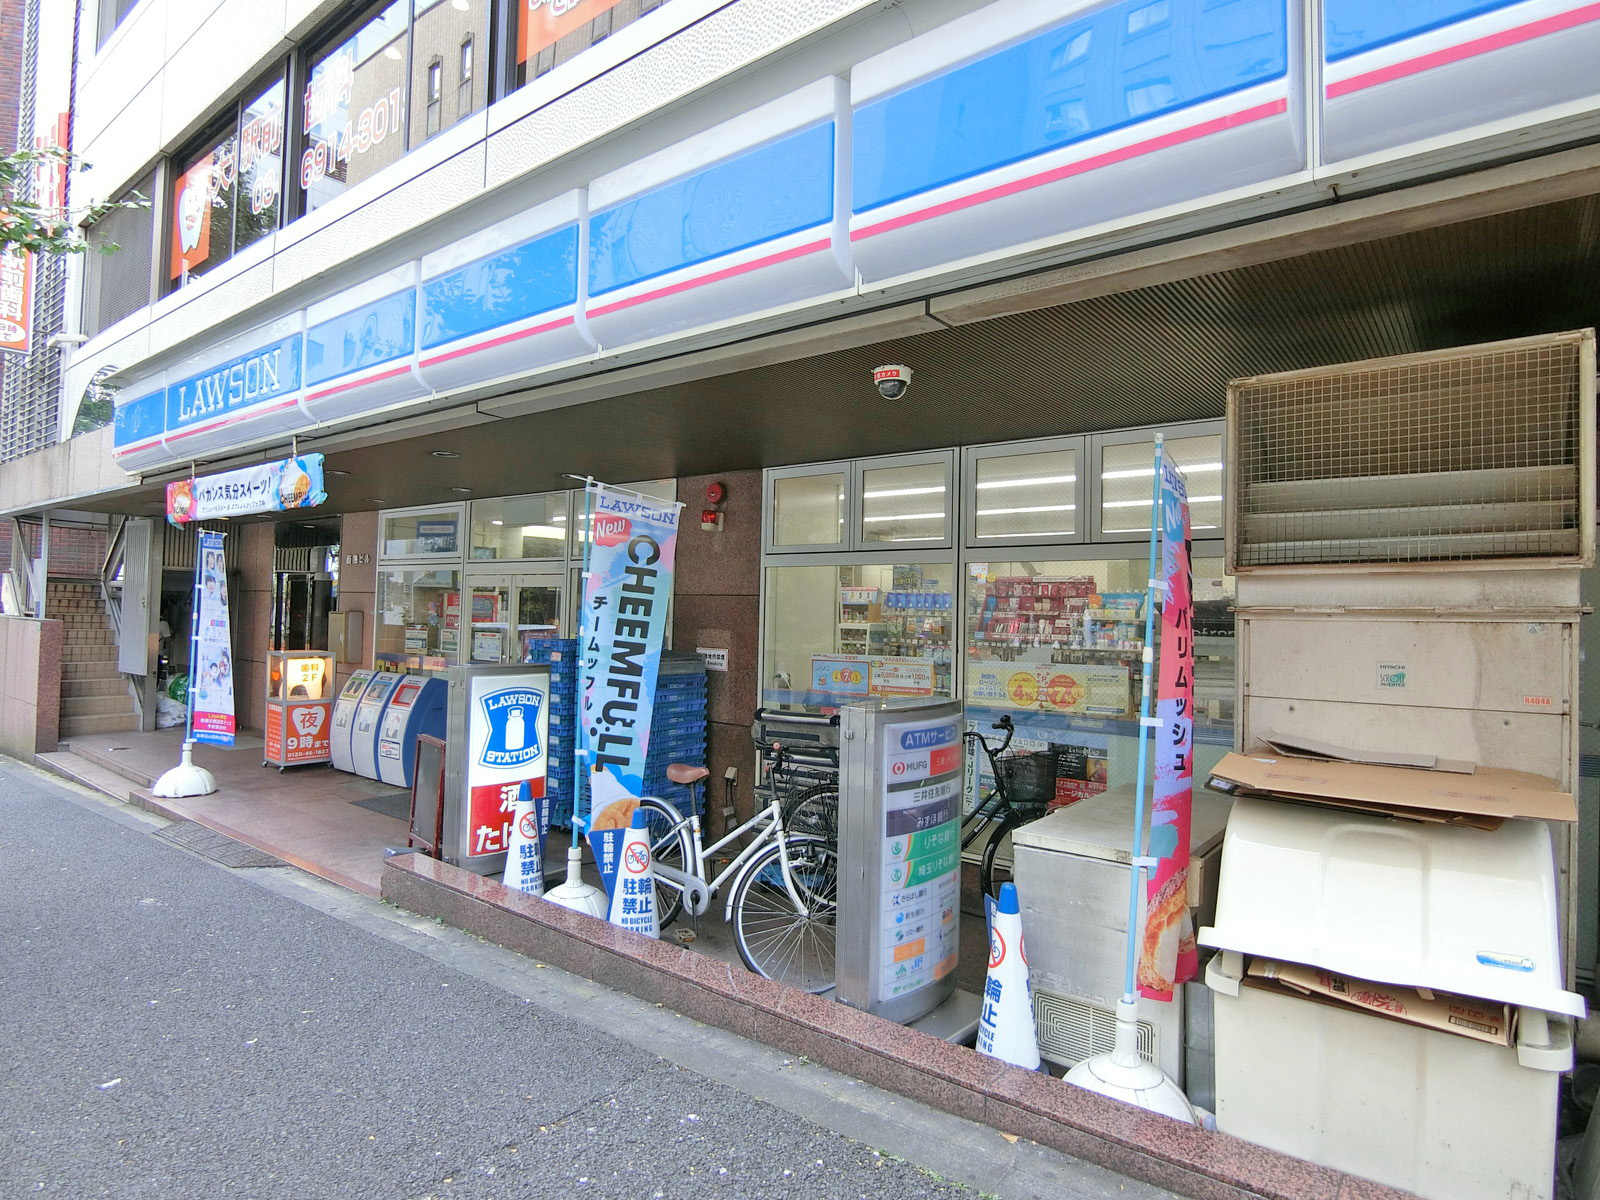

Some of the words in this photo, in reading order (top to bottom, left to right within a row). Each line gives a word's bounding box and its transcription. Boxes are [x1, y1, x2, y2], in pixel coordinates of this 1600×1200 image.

[178, 349, 282, 421] LAWSON
[199, 476, 271, 502] バカンス気分スイーツ!
[599, 496, 676, 525] LAWSON
[596, 519, 626, 540] New
[584, 596, 608, 711] チームッフル
[594, 534, 661, 773] CHEEMFULL
[301, 663, 319, 672] 歯科
[1172, 607, 1188, 771] パリムッシュ
[487, 694, 541, 711] LAWSON
[1524, 697, 1551, 705] R404A
[300, 711, 318, 729] 夜
[287, 736, 329, 750] 9時まで
[905, 725, 957, 747] ATMサービス
[486, 744, 539, 764] STATION
[906, 760, 928, 772] MUFG
[913, 783, 952, 803] 三井住友銀行
[916, 809, 949, 828] みずほ銀行
[603, 832, 614, 874] 駐輪禁止
[623, 877, 652, 895] 駐輪
[622, 896, 652, 914] 禁止
[621, 917, 628, 925] NO
[629, 915, 653, 924] BICYCLE
